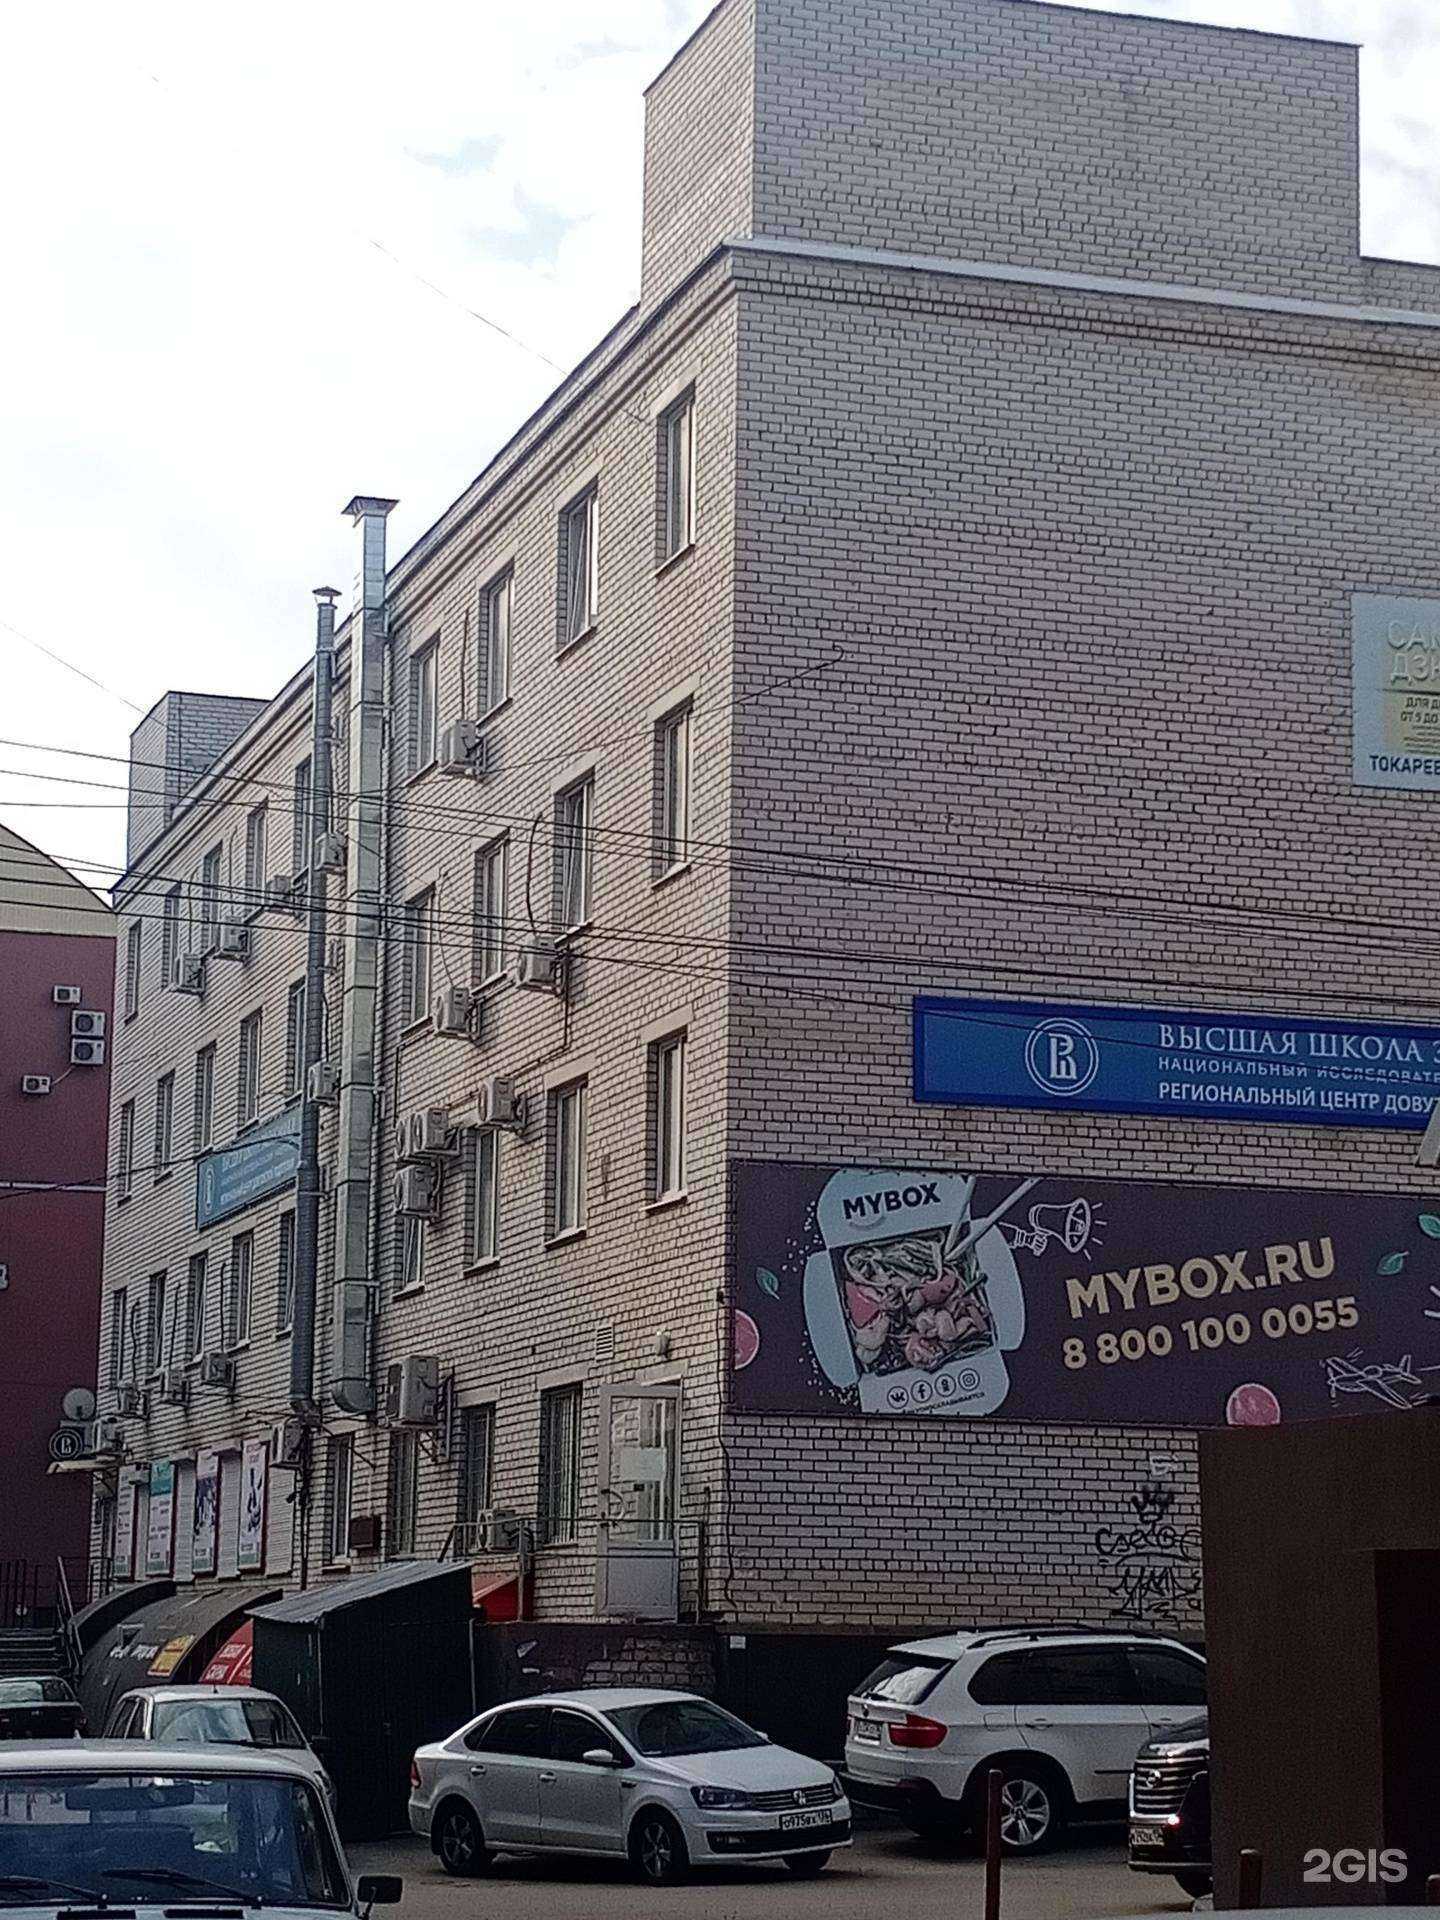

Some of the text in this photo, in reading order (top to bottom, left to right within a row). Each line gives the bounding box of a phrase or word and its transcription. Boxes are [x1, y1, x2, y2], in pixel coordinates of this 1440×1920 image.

[1159, 1024, 1296, 1055] ВЫСШАЯ
[1309, 1033, 1423, 1062] ШКОЛА
[1159, 1056, 1307, 1077] НАЦИОНАЛЬНЫЙ
[1159, 1082, 1440, 1114] РЕГИОНАЛЬНЫЙ ЦЕНТР ДОВУ
[842, 1182, 942, 1220] MYBOX
[1065, 1236, 1335, 1319] MYBOX.RU
[1063, 1296, 1359, 1370] 8 800 100 0055
